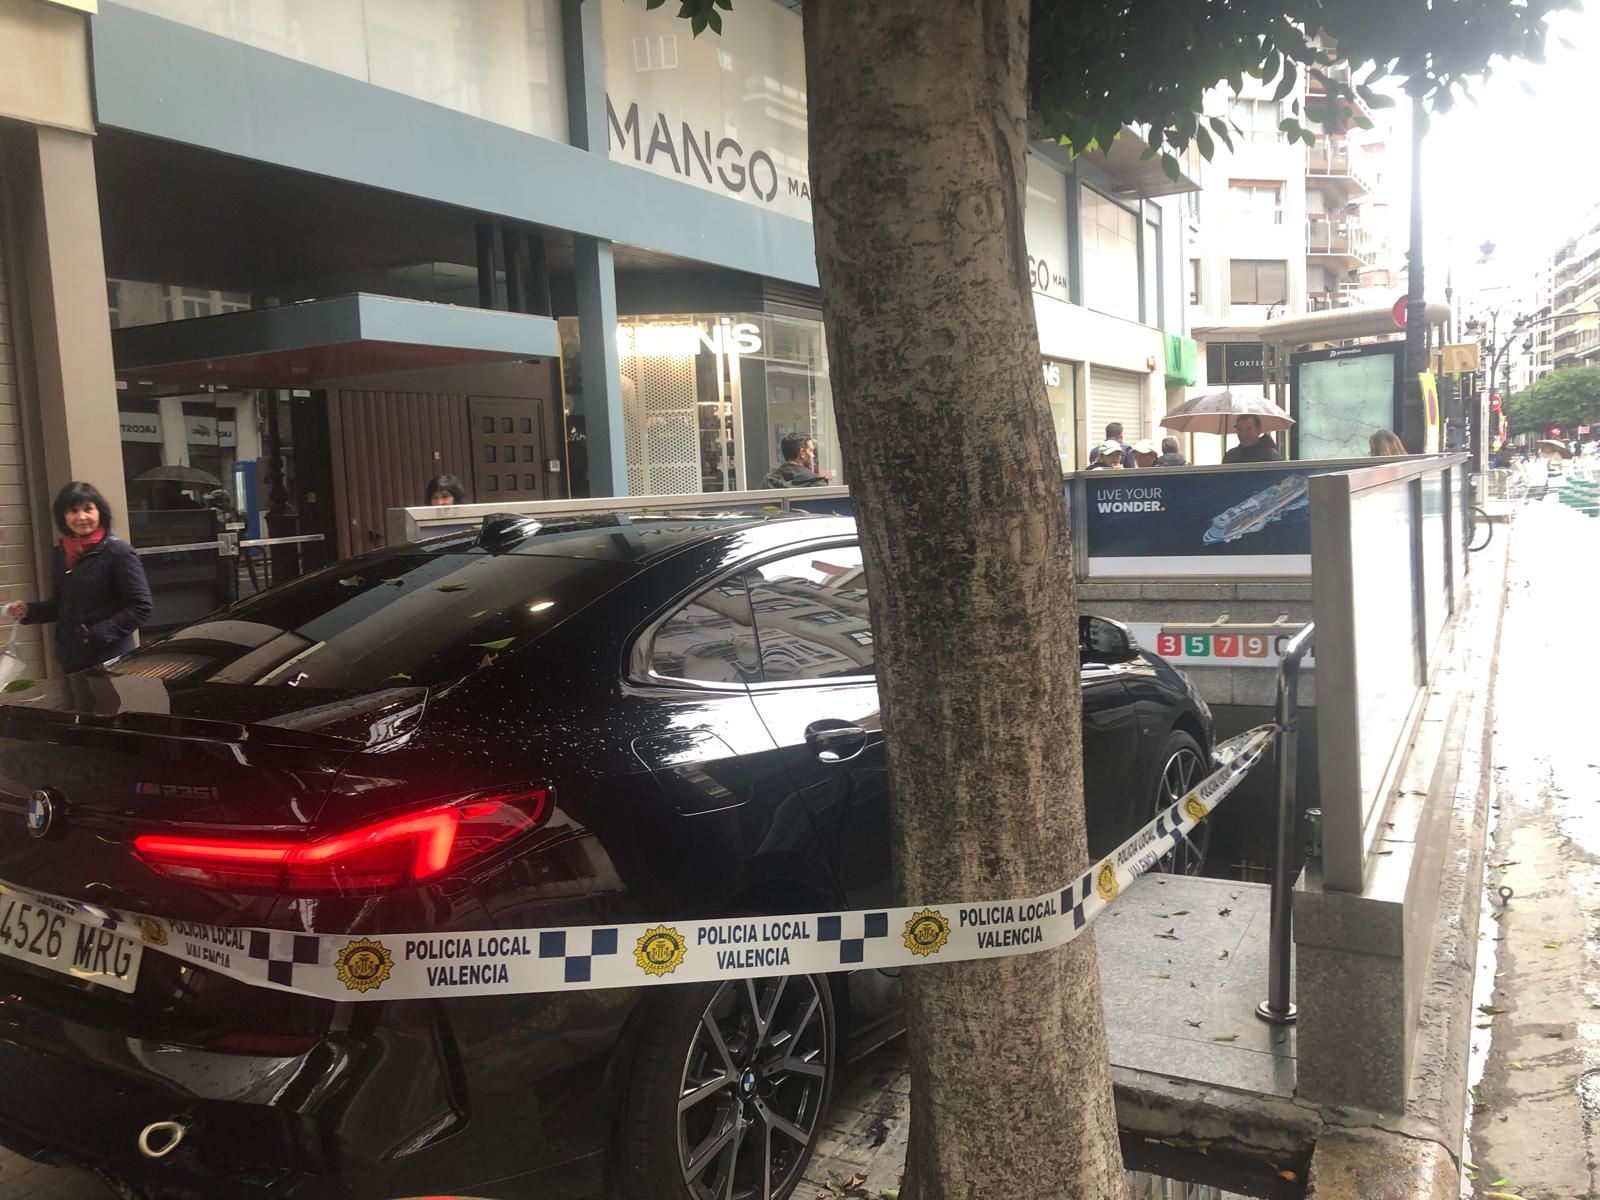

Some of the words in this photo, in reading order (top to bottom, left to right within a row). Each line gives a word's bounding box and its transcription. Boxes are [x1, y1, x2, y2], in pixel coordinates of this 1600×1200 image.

[605, 92, 778, 203] MANGO
[788, 177, 811, 201] MA
[1053, 273, 1067, 289] MAN
[1097, 488, 1122, 501] LIVE
[1125, 487, 1162, 499] YOUR
[1097, 500, 1167, 514] WONDER.
[1163, 636, 1175, 651] 3
[1191, 636, 1204, 651] 5
[1219, 636, 1232, 651] 7
[1247, 635, 1262, 652] 9
[959, 905, 1015, 927] POLICIA
[1018, 898, 1057, 922] LOCAL
[0, 901, 66, 958] 4526
[73, 923, 134, 979] MRG
[168, 918, 210, 940] POLICIA
[212, 925, 245, 951] LOCAL
[697, 924, 757, 945] POLICIA
[762, 921, 810, 942] LOCAL
[977, 925, 1043, 949] VALENCIA
[185, 942, 230, 968] VALENCIA
[405, 938, 472, 960] POLICIA
[478, 936, 531, 958] LOCAL
[717, 947, 790, 970] VALENCIA
[427, 963, 509, 986] VALENCIA
